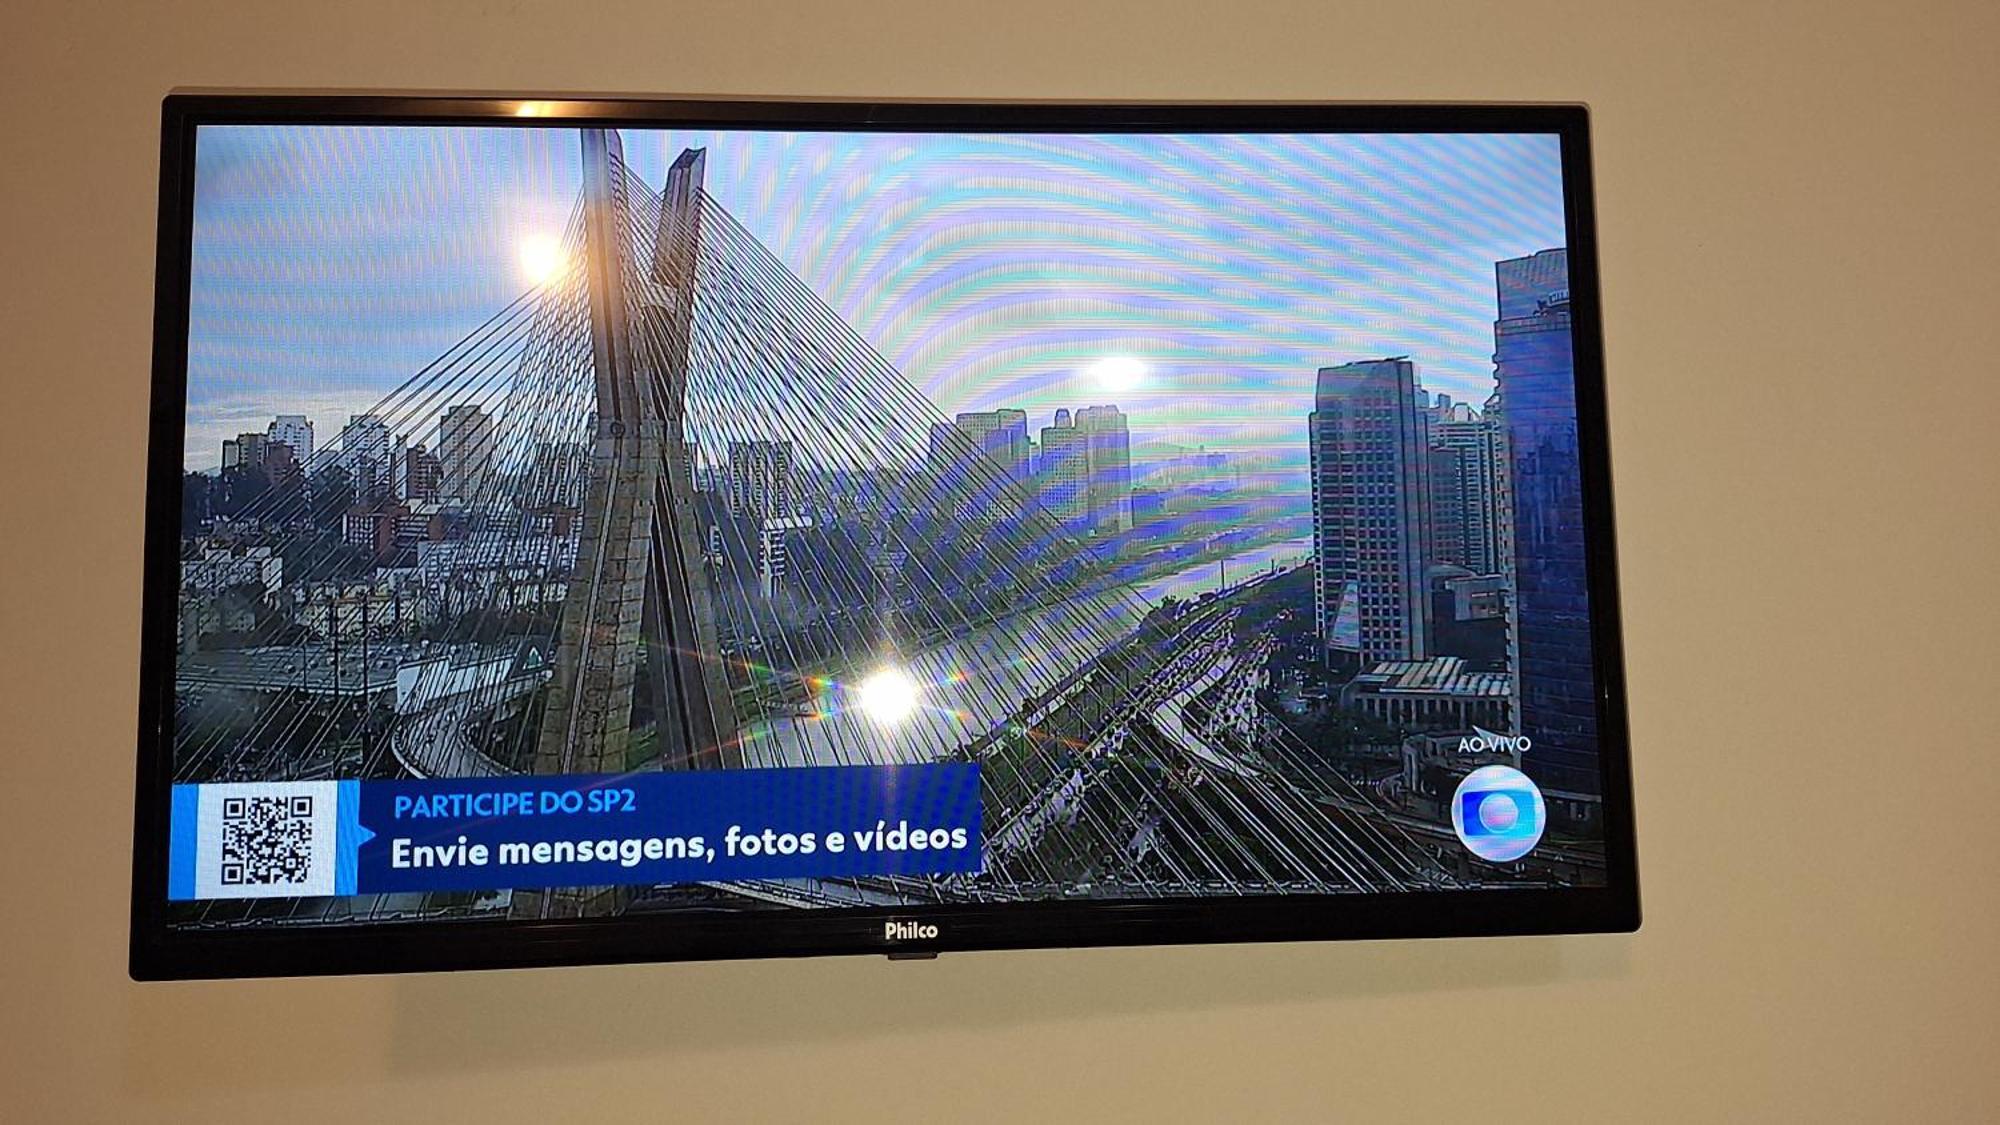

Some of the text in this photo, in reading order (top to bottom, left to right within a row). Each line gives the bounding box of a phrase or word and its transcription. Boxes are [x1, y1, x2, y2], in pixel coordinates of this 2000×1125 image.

[1458, 736, 1532, 753] AO VIVO
[394, 788, 636, 819] PARTICIPE DO SP2
[391, 820, 967, 868] Envie mensagens, fotos e vídeos
[885, 921, 938, 940] Philco
